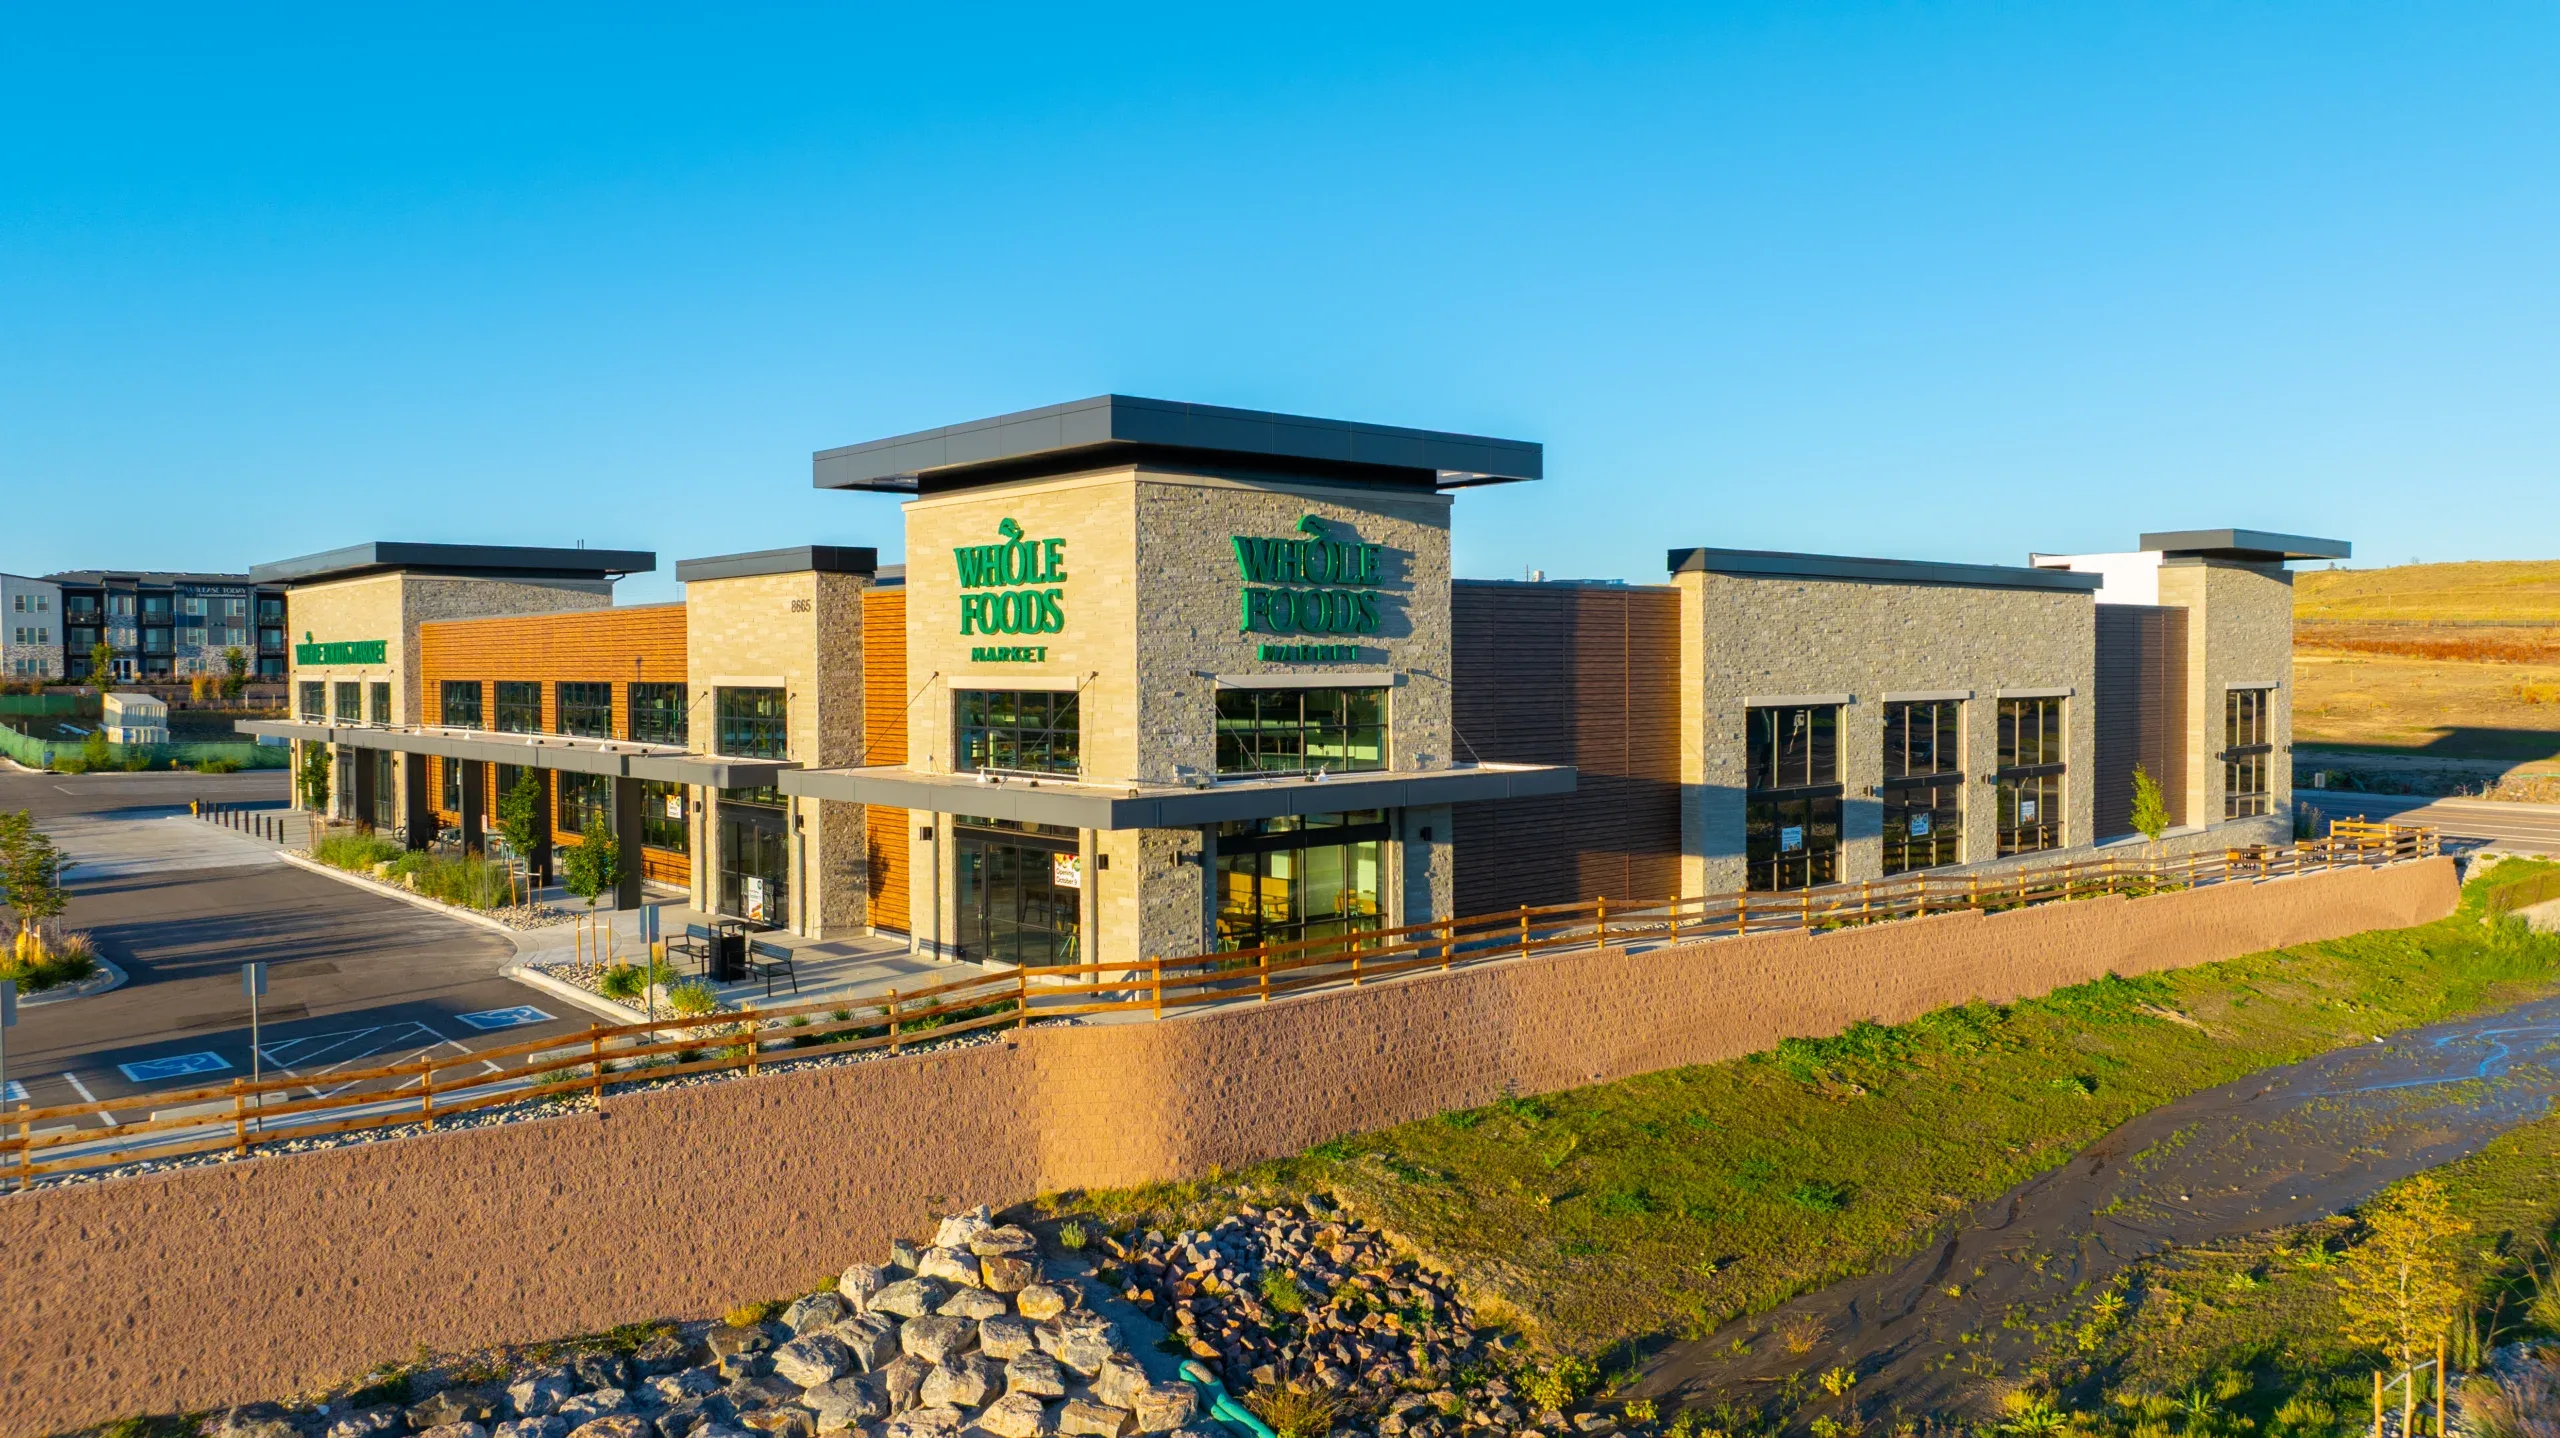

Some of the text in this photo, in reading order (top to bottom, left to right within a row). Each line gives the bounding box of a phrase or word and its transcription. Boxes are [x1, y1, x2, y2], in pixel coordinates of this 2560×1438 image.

[953, 537, 1068, 589] WHOLE
[1229, 535, 1384, 586] WHOLE
[791, 599, 811, 613] 8665
[959, 588, 1065, 636] FOODS
[1240, 586, 1381, 634] FOODS
[971, 646, 1048, 663] MARKET
